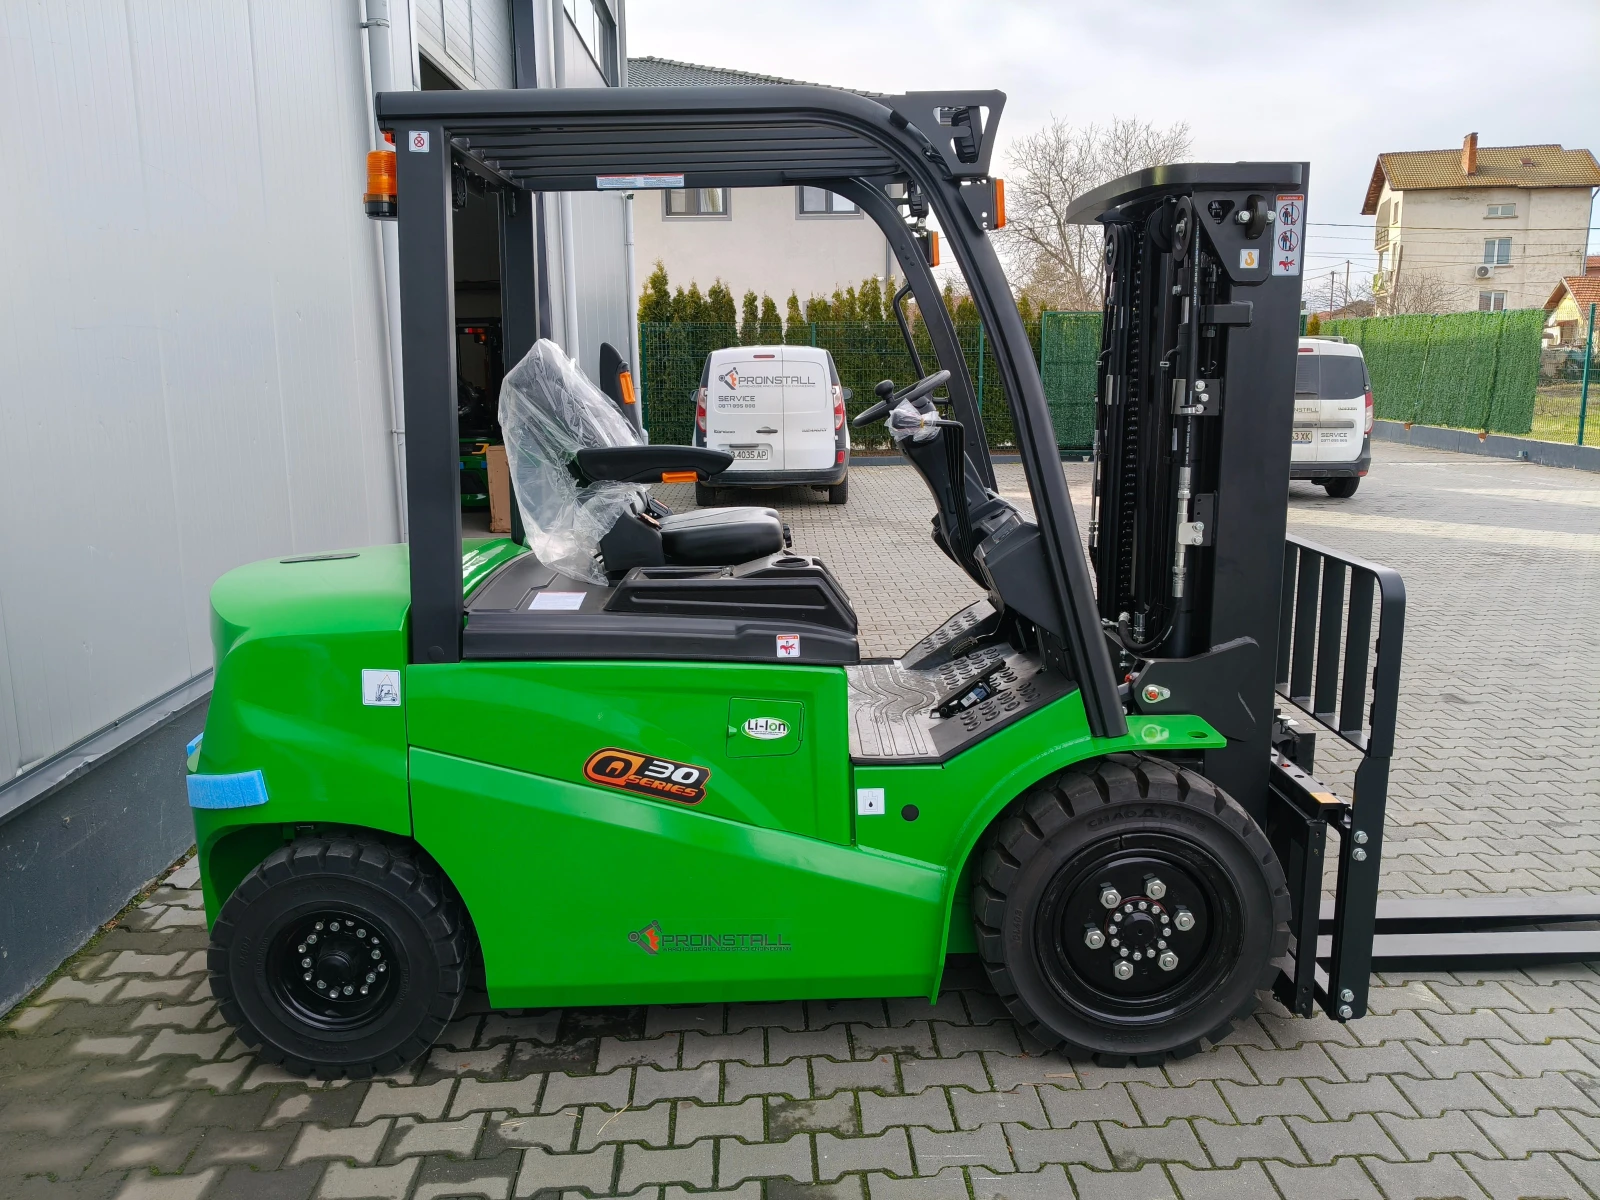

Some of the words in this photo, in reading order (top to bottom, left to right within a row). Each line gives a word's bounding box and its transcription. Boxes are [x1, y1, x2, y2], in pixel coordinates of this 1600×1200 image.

[738, 376, 815, 385] PROINSTALL
[737, 451, 755, 459] 4035
[756, 451, 767, 459] AP
[747, 719, 786, 731] Li-Ion
[644, 760, 700, 784] 30
[625, 774, 698, 797] SERIES
[661, 934, 791, 947] PROINSTALL
